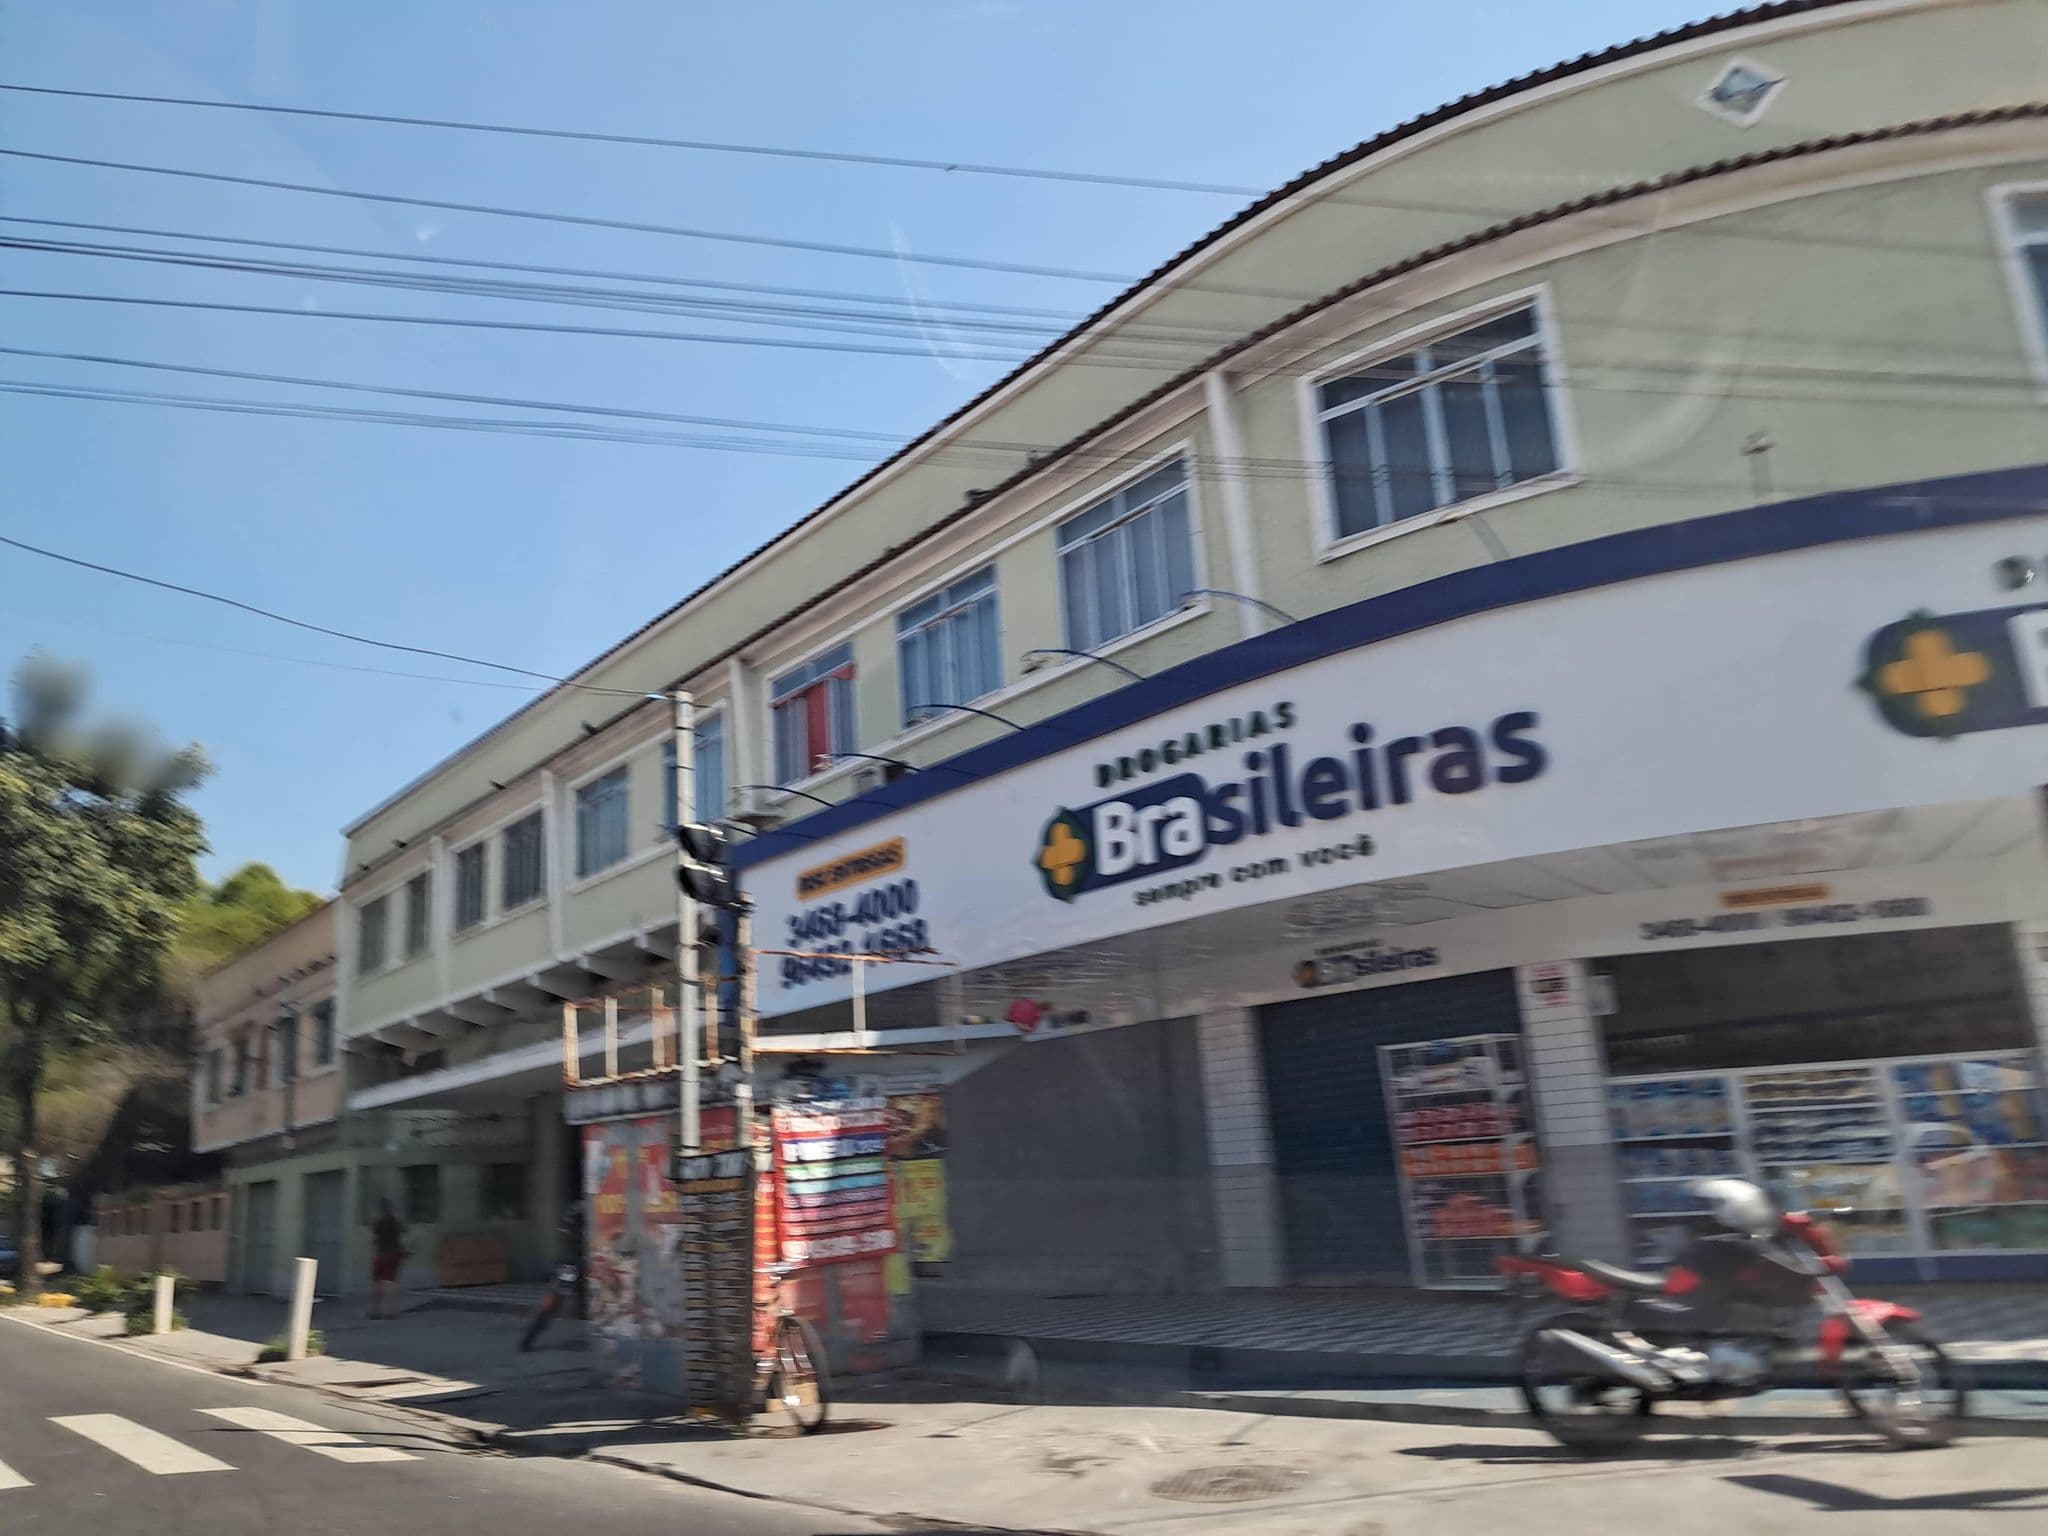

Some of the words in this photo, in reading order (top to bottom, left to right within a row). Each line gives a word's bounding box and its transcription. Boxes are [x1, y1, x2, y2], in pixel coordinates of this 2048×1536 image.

[1095, 701, 1298, 788] DROGARIAS
[1094, 710, 1548, 877] Brasileiras
[1134, 872, 1222, 907] sempre
[1229, 856, 1292, 883] com
[1297, 832, 1376, 867] você
